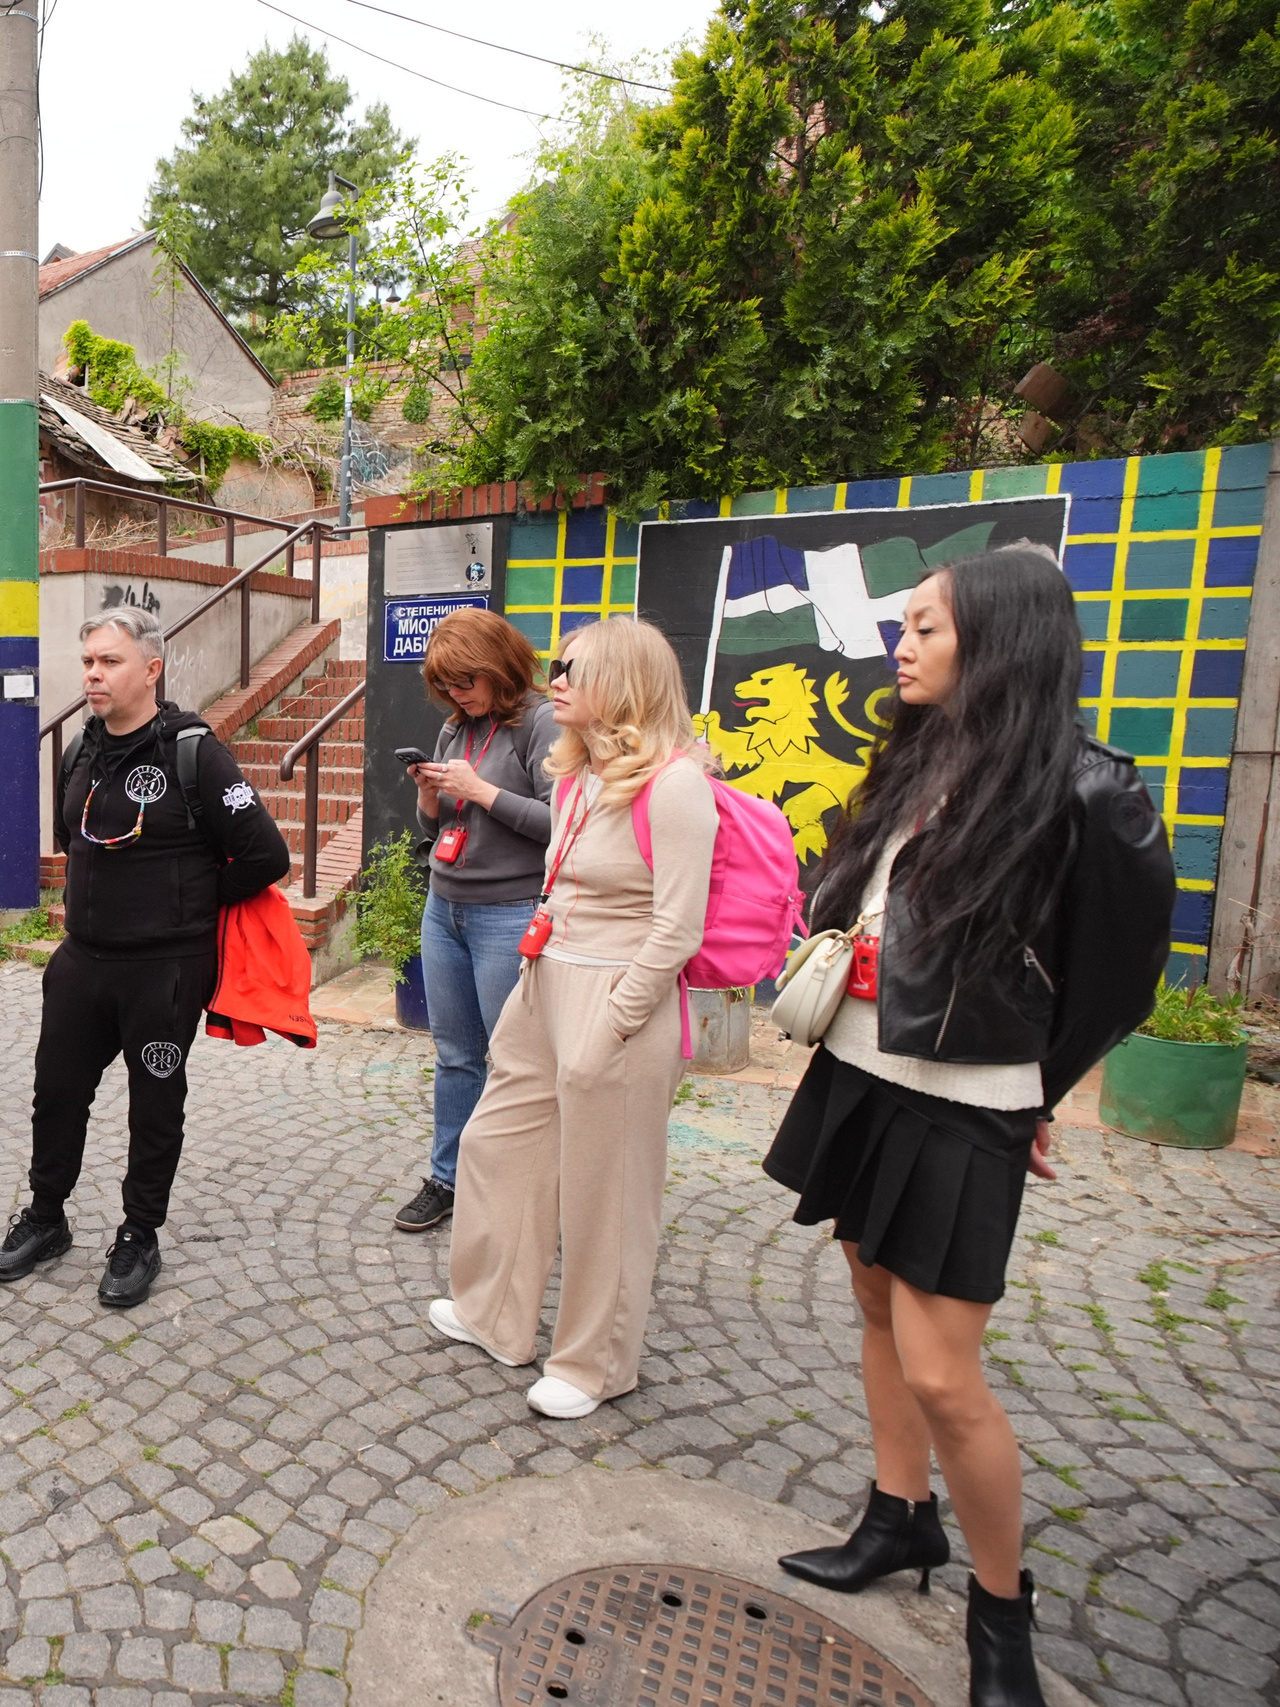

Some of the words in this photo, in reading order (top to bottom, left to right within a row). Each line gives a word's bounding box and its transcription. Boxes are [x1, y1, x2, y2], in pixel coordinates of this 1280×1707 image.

[399, 604, 473, 617] СТЕПЕНИШ
[398, 617, 444, 637] МИОД
[393, 637, 430, 656] ДАБИ
[585, 1644, 609, 1680] GGG
